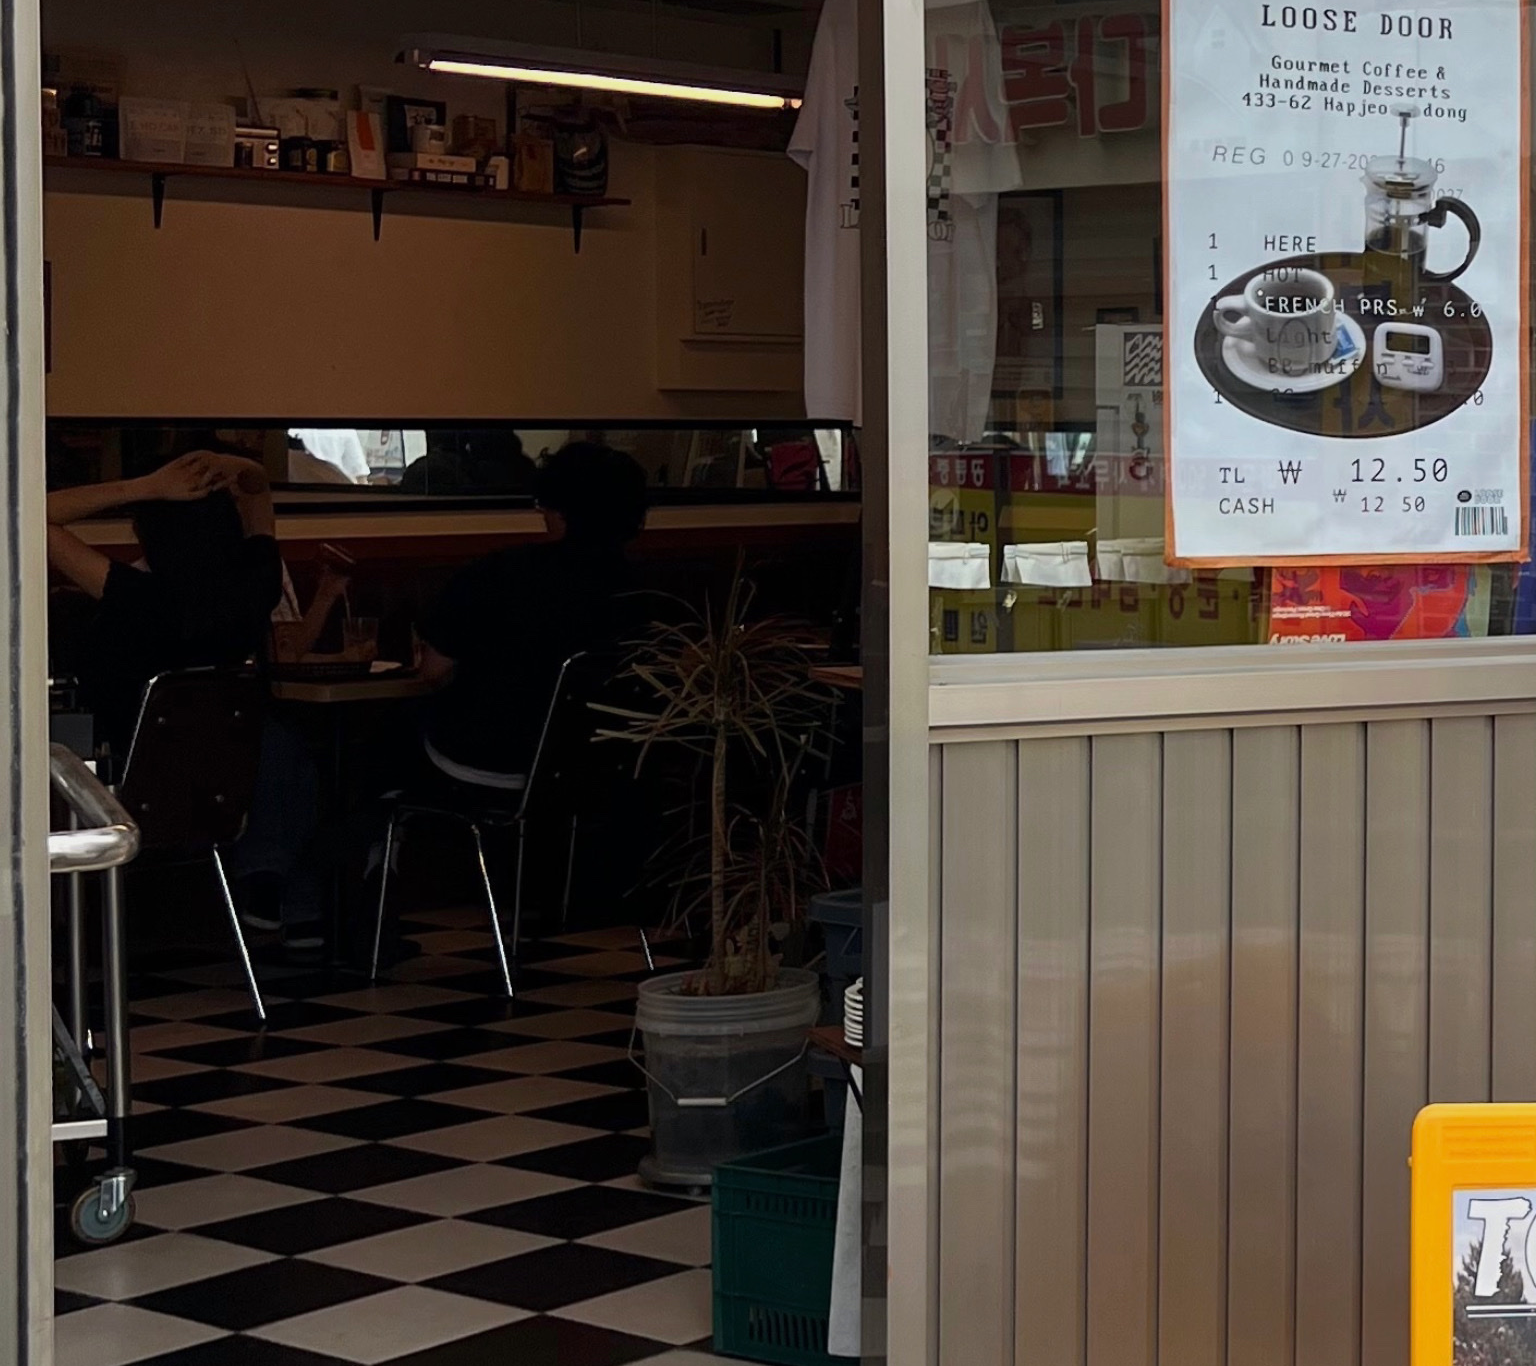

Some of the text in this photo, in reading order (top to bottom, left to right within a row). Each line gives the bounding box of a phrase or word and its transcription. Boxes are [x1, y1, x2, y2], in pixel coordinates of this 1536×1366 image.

[1261, 4, 1454, 40] LOOSE DOOR
[1271, 55, 1446, 80] Gourmet Coffee &
[1258, 74, 1451, 100] Handmade Desserts
[1242, 93, 1311, 110] 433-62
[1212, 146, 1266, 165] REG
[1208, 233, 1317, 252] 1 HERE
[1208, 264, 1303, 283] 1 HOT
[1265, 296, 1345, 316] FRENCH
[1266, 327, 1333, 348] Light
[1308, 359, 1389, 376] muffn
[1219, 467, 1246, 484] TL
[1350, 458, 1450, 483] 12.50
[1219, 498, 1275, 515] CASH
